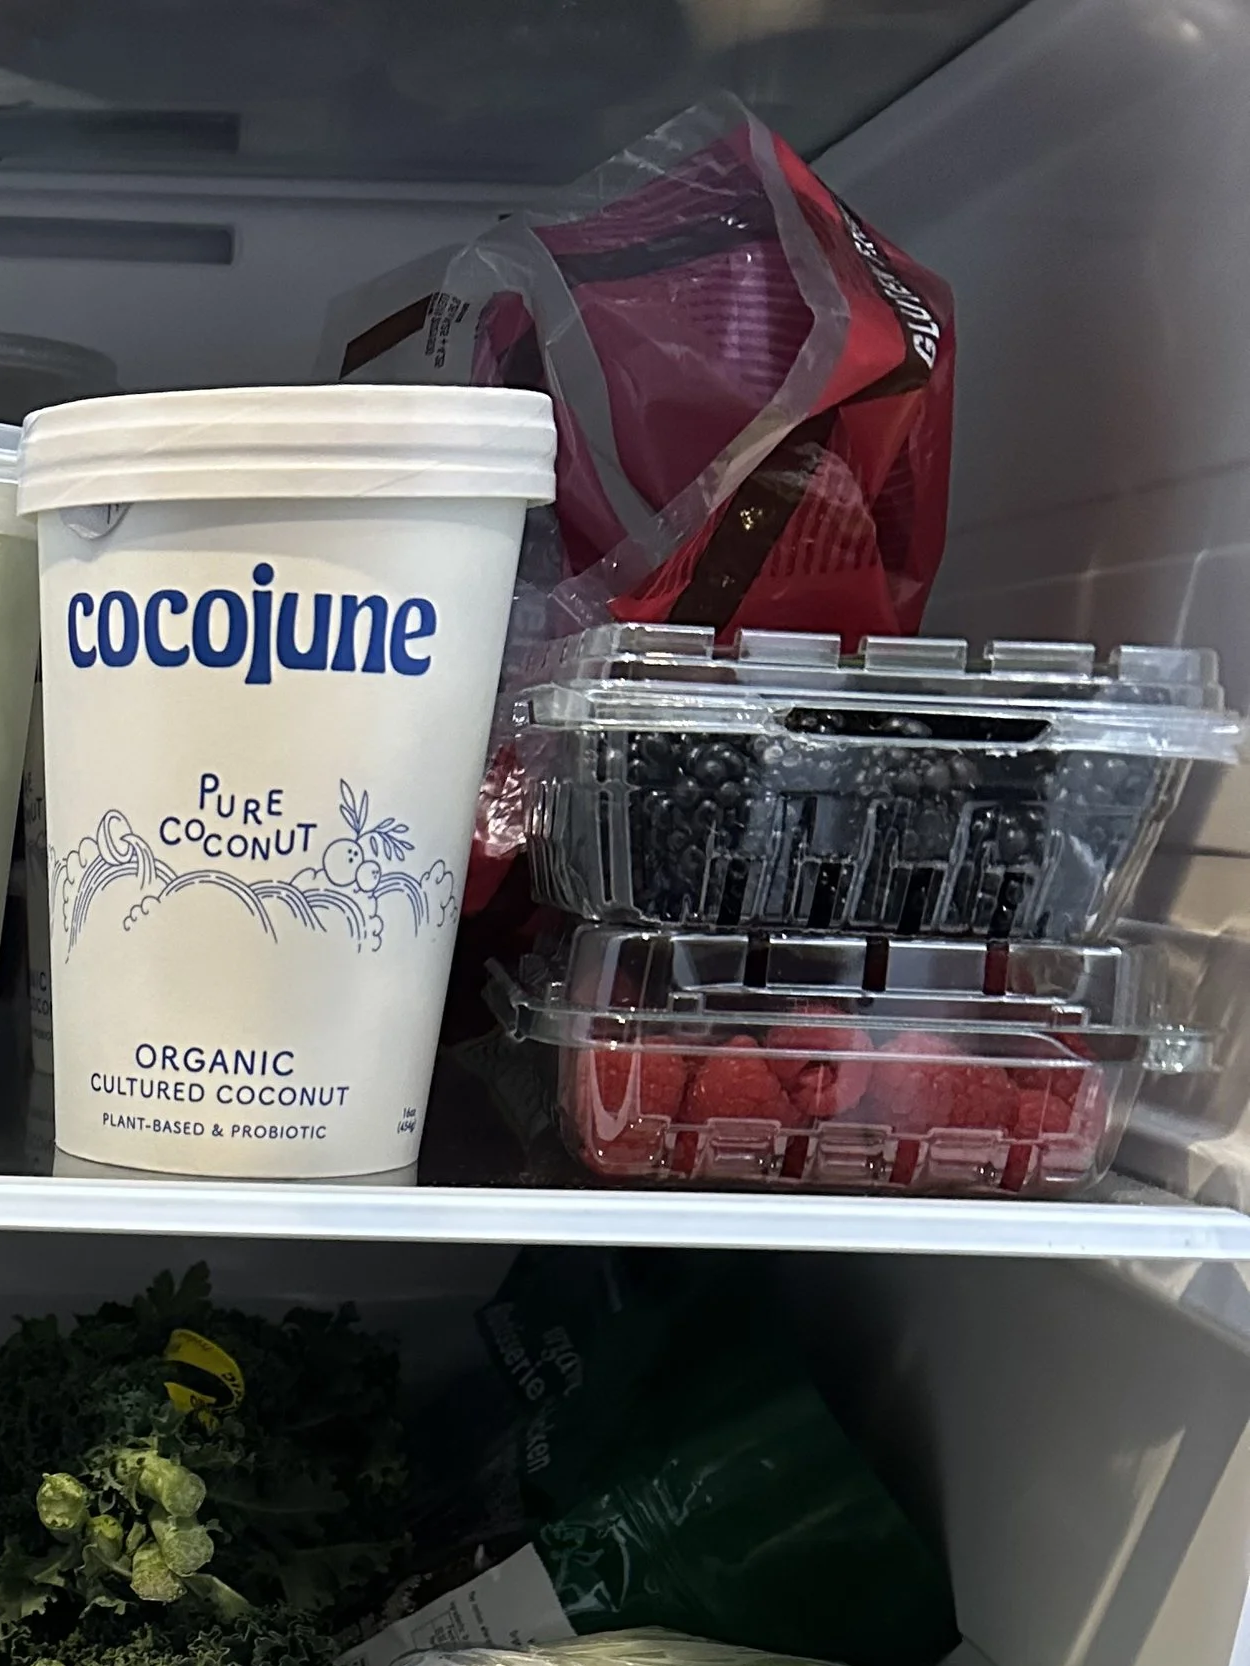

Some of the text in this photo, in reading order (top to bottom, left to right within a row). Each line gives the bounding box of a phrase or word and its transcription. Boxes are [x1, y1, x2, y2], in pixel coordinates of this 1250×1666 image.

[67, 562, 437, 685] cocojune
[198, 773, 284, 826] PURE
[158, 816, 318, 861] COCONUT
[134, 1043, 295, 1078] ORGANIC
[90, 1073, 350, 1107] CULTURED COCONUT
[102, 1112, 327, 1140] PLANT-BASED & PROBIOTIC
